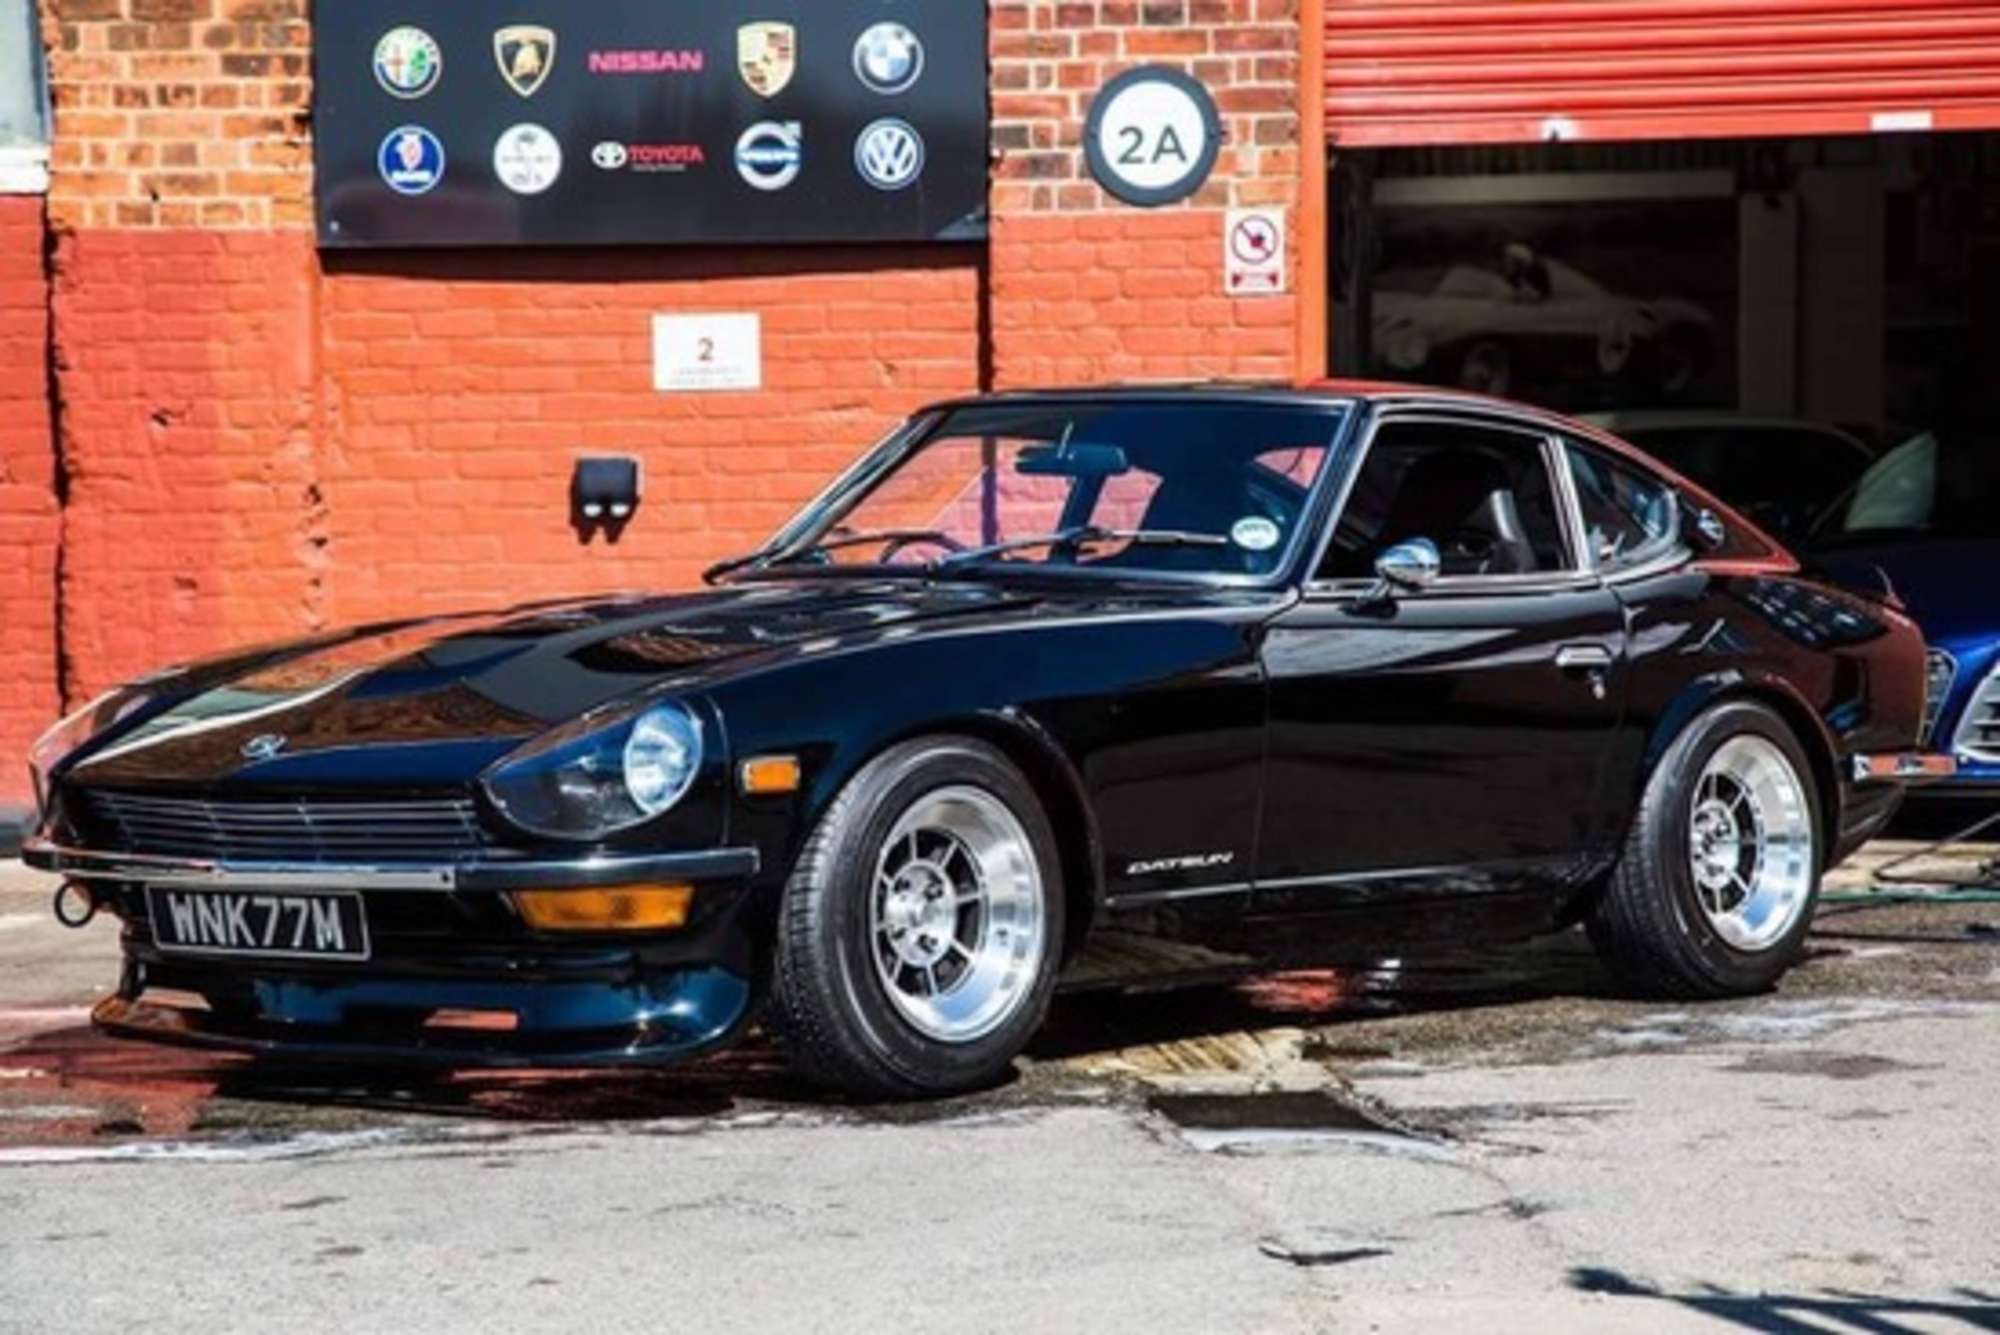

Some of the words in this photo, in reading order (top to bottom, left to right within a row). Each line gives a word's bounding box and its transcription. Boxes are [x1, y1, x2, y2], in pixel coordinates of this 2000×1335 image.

[588, 50, 703, 72] NISSAN
[628, 144, 705, 163] TOYOTA
[1116, 124, 1188, 165] 2A
[697, 336, 716, 362] 2
[166, 893, 345, 950] WNK77M
